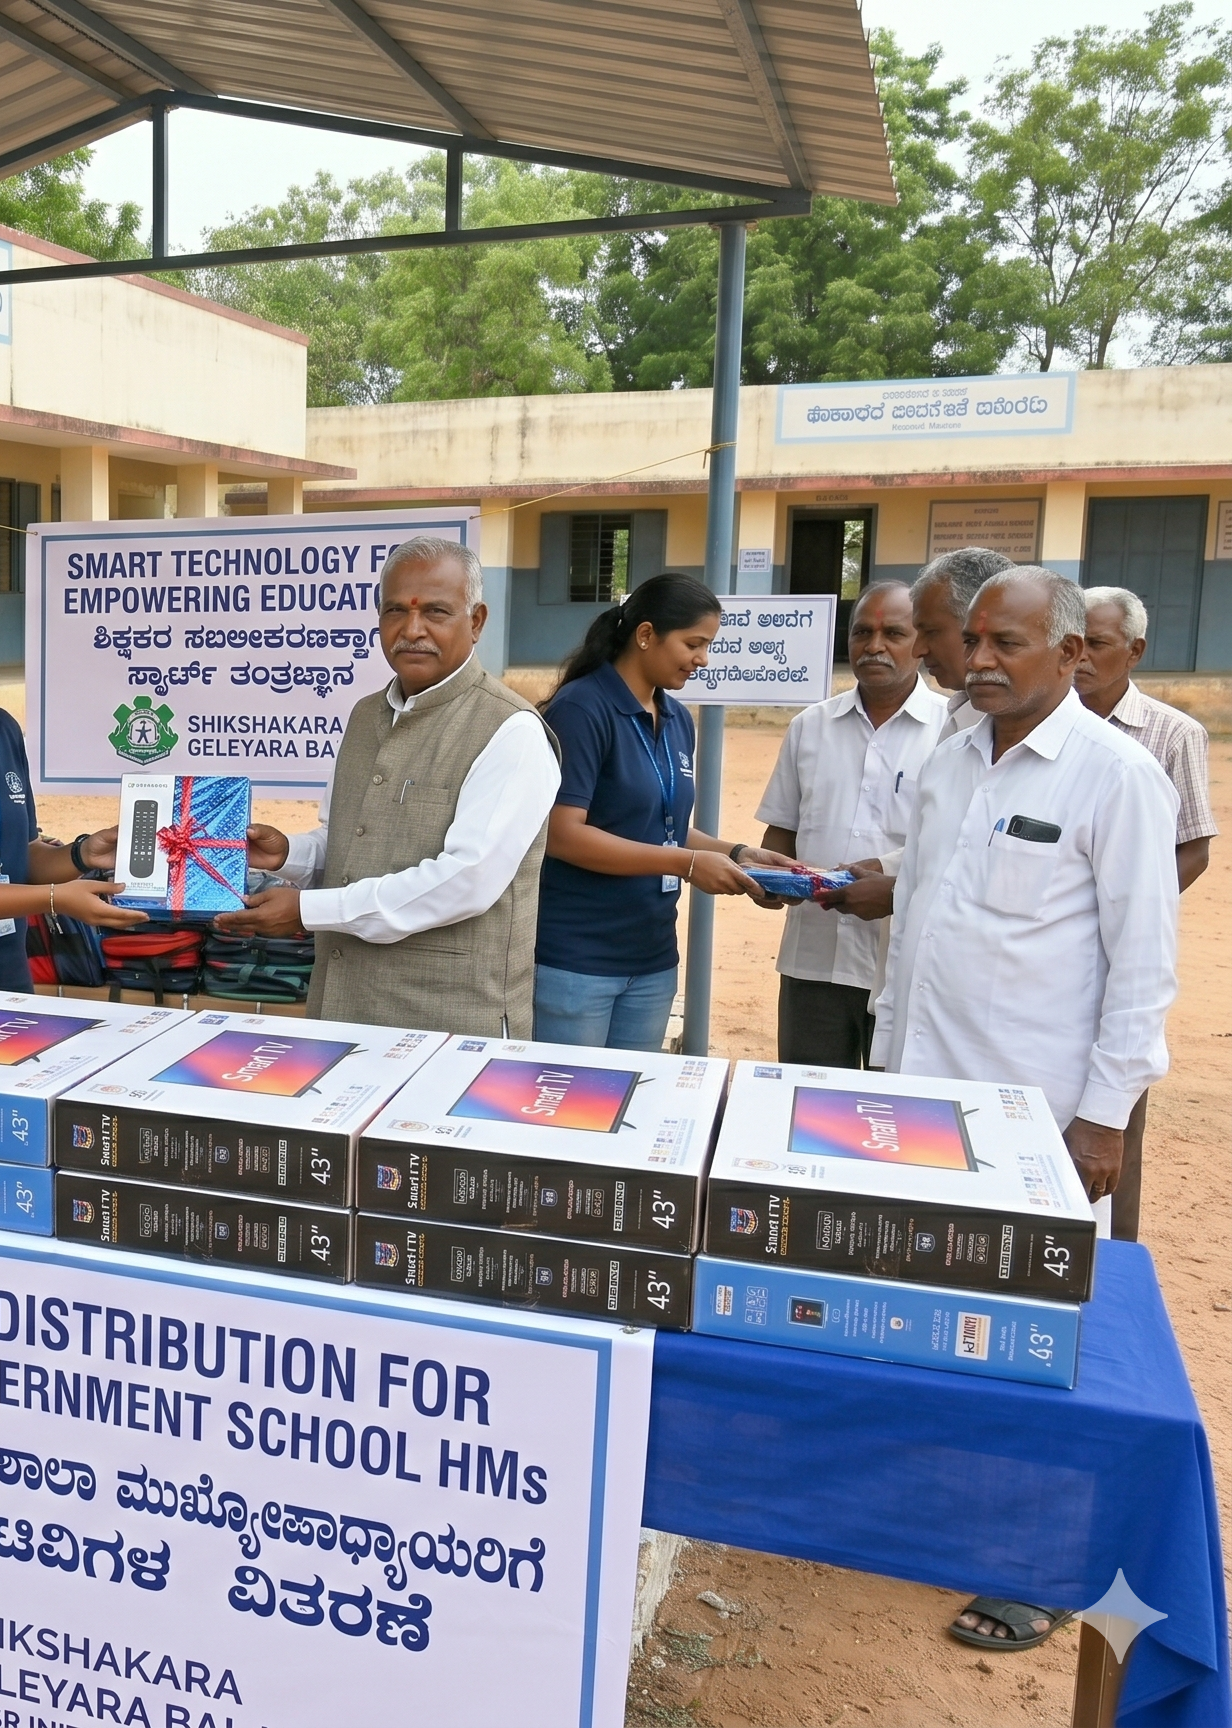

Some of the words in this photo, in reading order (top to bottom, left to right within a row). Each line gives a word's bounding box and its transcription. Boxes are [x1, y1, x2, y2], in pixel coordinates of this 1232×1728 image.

[67, 551, 163, 580] SMART
[171, 545, 360, 577] TECHNOLOGY
[64, 585, 251, 614] EMPOWERING
[261, 582, 381, 612] EDUCAT
[93, 624, 172, 660] ಶಿಕ್ಷಕರ
[187, 715, 343, 734] SHIKSHAKARA
[188, 738, 299, 757] GELEYARA
[306, 739, 339, 758] BA
[6, 1016, 39, 1033] TV
[260, 1040, 294, 1057] TV
[536, 1069, 575, 1085] TV
[856, 1098, 894, 1115] TV
[311, 1147, 331, 1185] 43"
[652, 1189, 676, 1230] 43"
[311, 1224, 331, 1262] 43"
[1043, 1234, 1071, 1278] 43"
[647, 1269, 671, 1310] 43"
[378, 1352, 492, 1427] FOR
[227, 1400, 422, 1484] SCHOOL
[438, 1438, 548, 1505] HMs
[116, 1463, 546, 1593] ಮುಖ್ಯೋಪಾಧ್ಯಾಯರಿಗೆ
[227, 1564, 433, 1652] ವಿತರಣೆ
